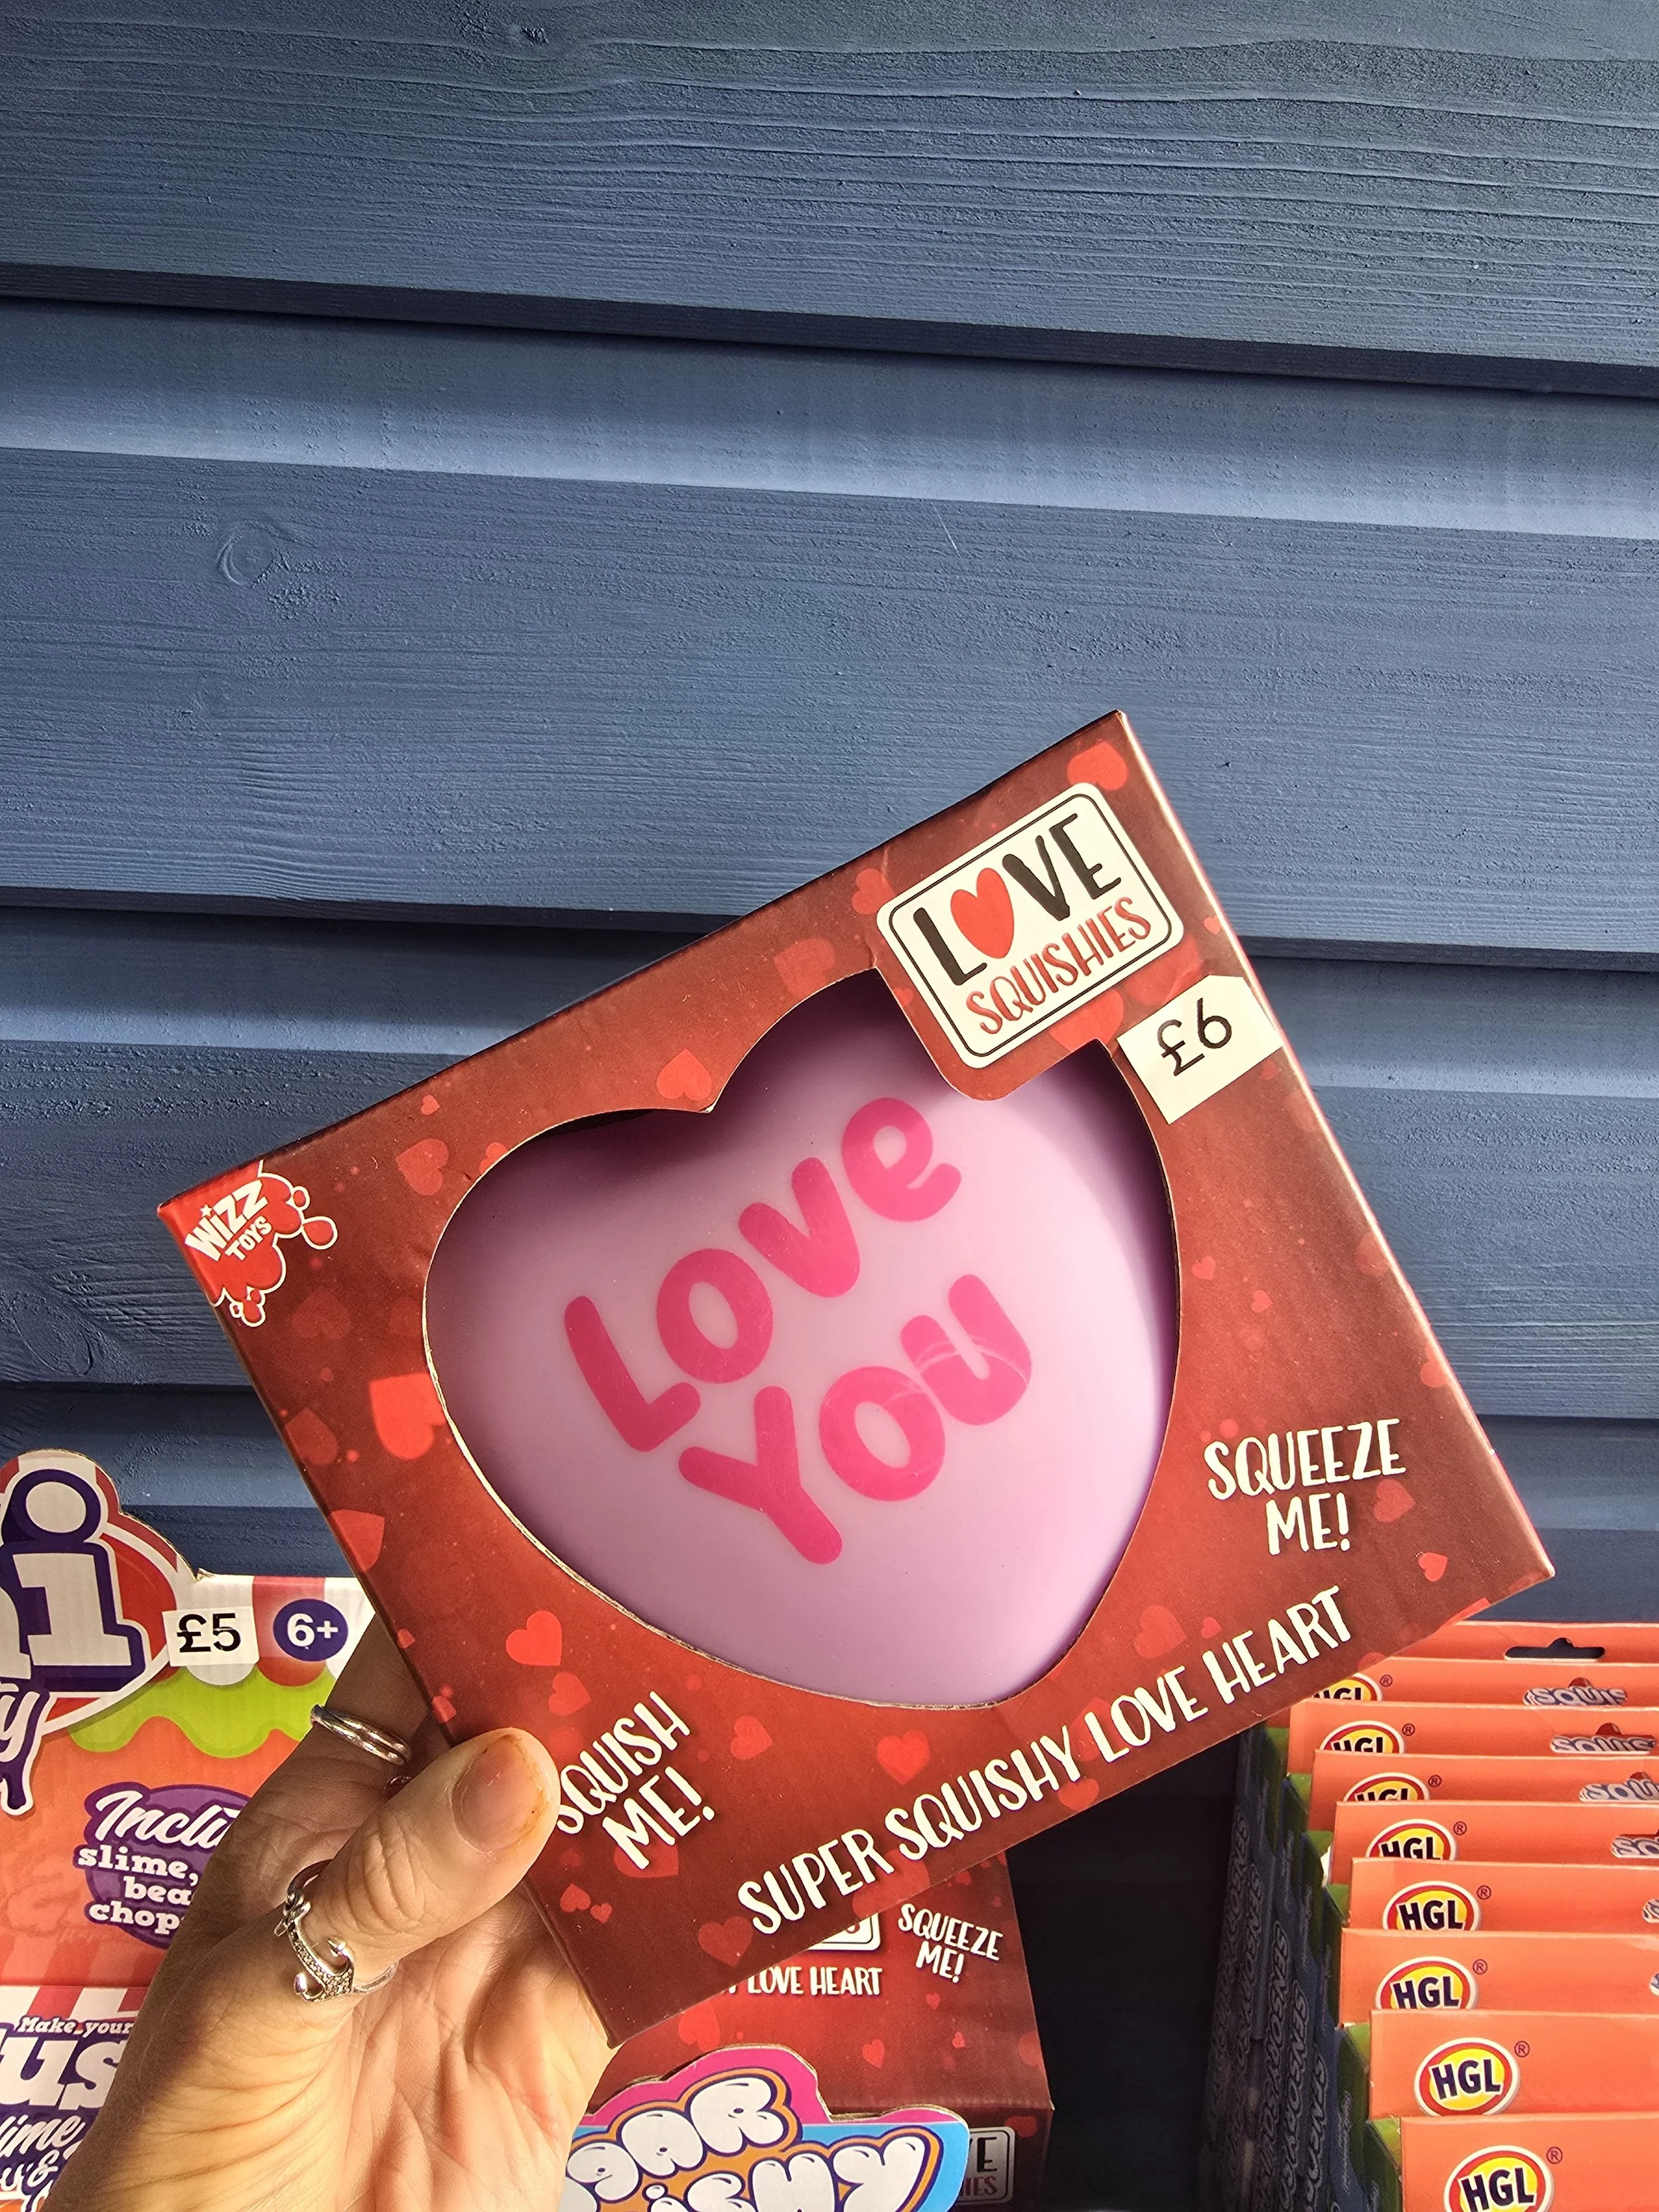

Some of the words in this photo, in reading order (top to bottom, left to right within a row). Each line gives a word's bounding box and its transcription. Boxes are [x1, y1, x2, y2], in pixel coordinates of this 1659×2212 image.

[966, 896, 1151, 1035] SQUISHIES
[1157, 997, 1232, 1076] £6
[224, 1215, 272, 1261] TOYS
[1203, 1418, 1406, 1501] SQUEEZE
[1265, 1492, 1350, 1556] ME!
[177, 1613, 242, 1653] £5
[287, 1613, 338, 1647] 6+
[556, 1690, 691, 1834] SQUISH
[737, 1828, 895, 1935] SUPER
[885, 1725, 1081, 1861] SQUISHY
[1084, 1665, 1208, 1763] LOVE
[1202, 1585, 1351, 1704] HEART
[95, 1790, 241, 1849] Inclu
[602, 1765, 715, 1870] ME!
[78, 1844, 199, 1887] slime,
[123, 1876, 192, 1906] bea
[89, 1901, 184, 1935] chop
[899, 1903, 1004, 1962] SQUEEZE
[1399, 1900, 1464, 1930] HGL
[748, 1966, 804, 1994] LOVE
[809, 1966, 883, 1996] HEART
[916, 1943, 965, 1984] ME!
[1392, 1976, 1459, 2009] HGL
[17, 2018, 74, 2034] Make
[82, 2022, 135, 2038] your
[1432, 2059, 1502, 2100] HGL
[1461, 2168, 1536, 2212] HGL
